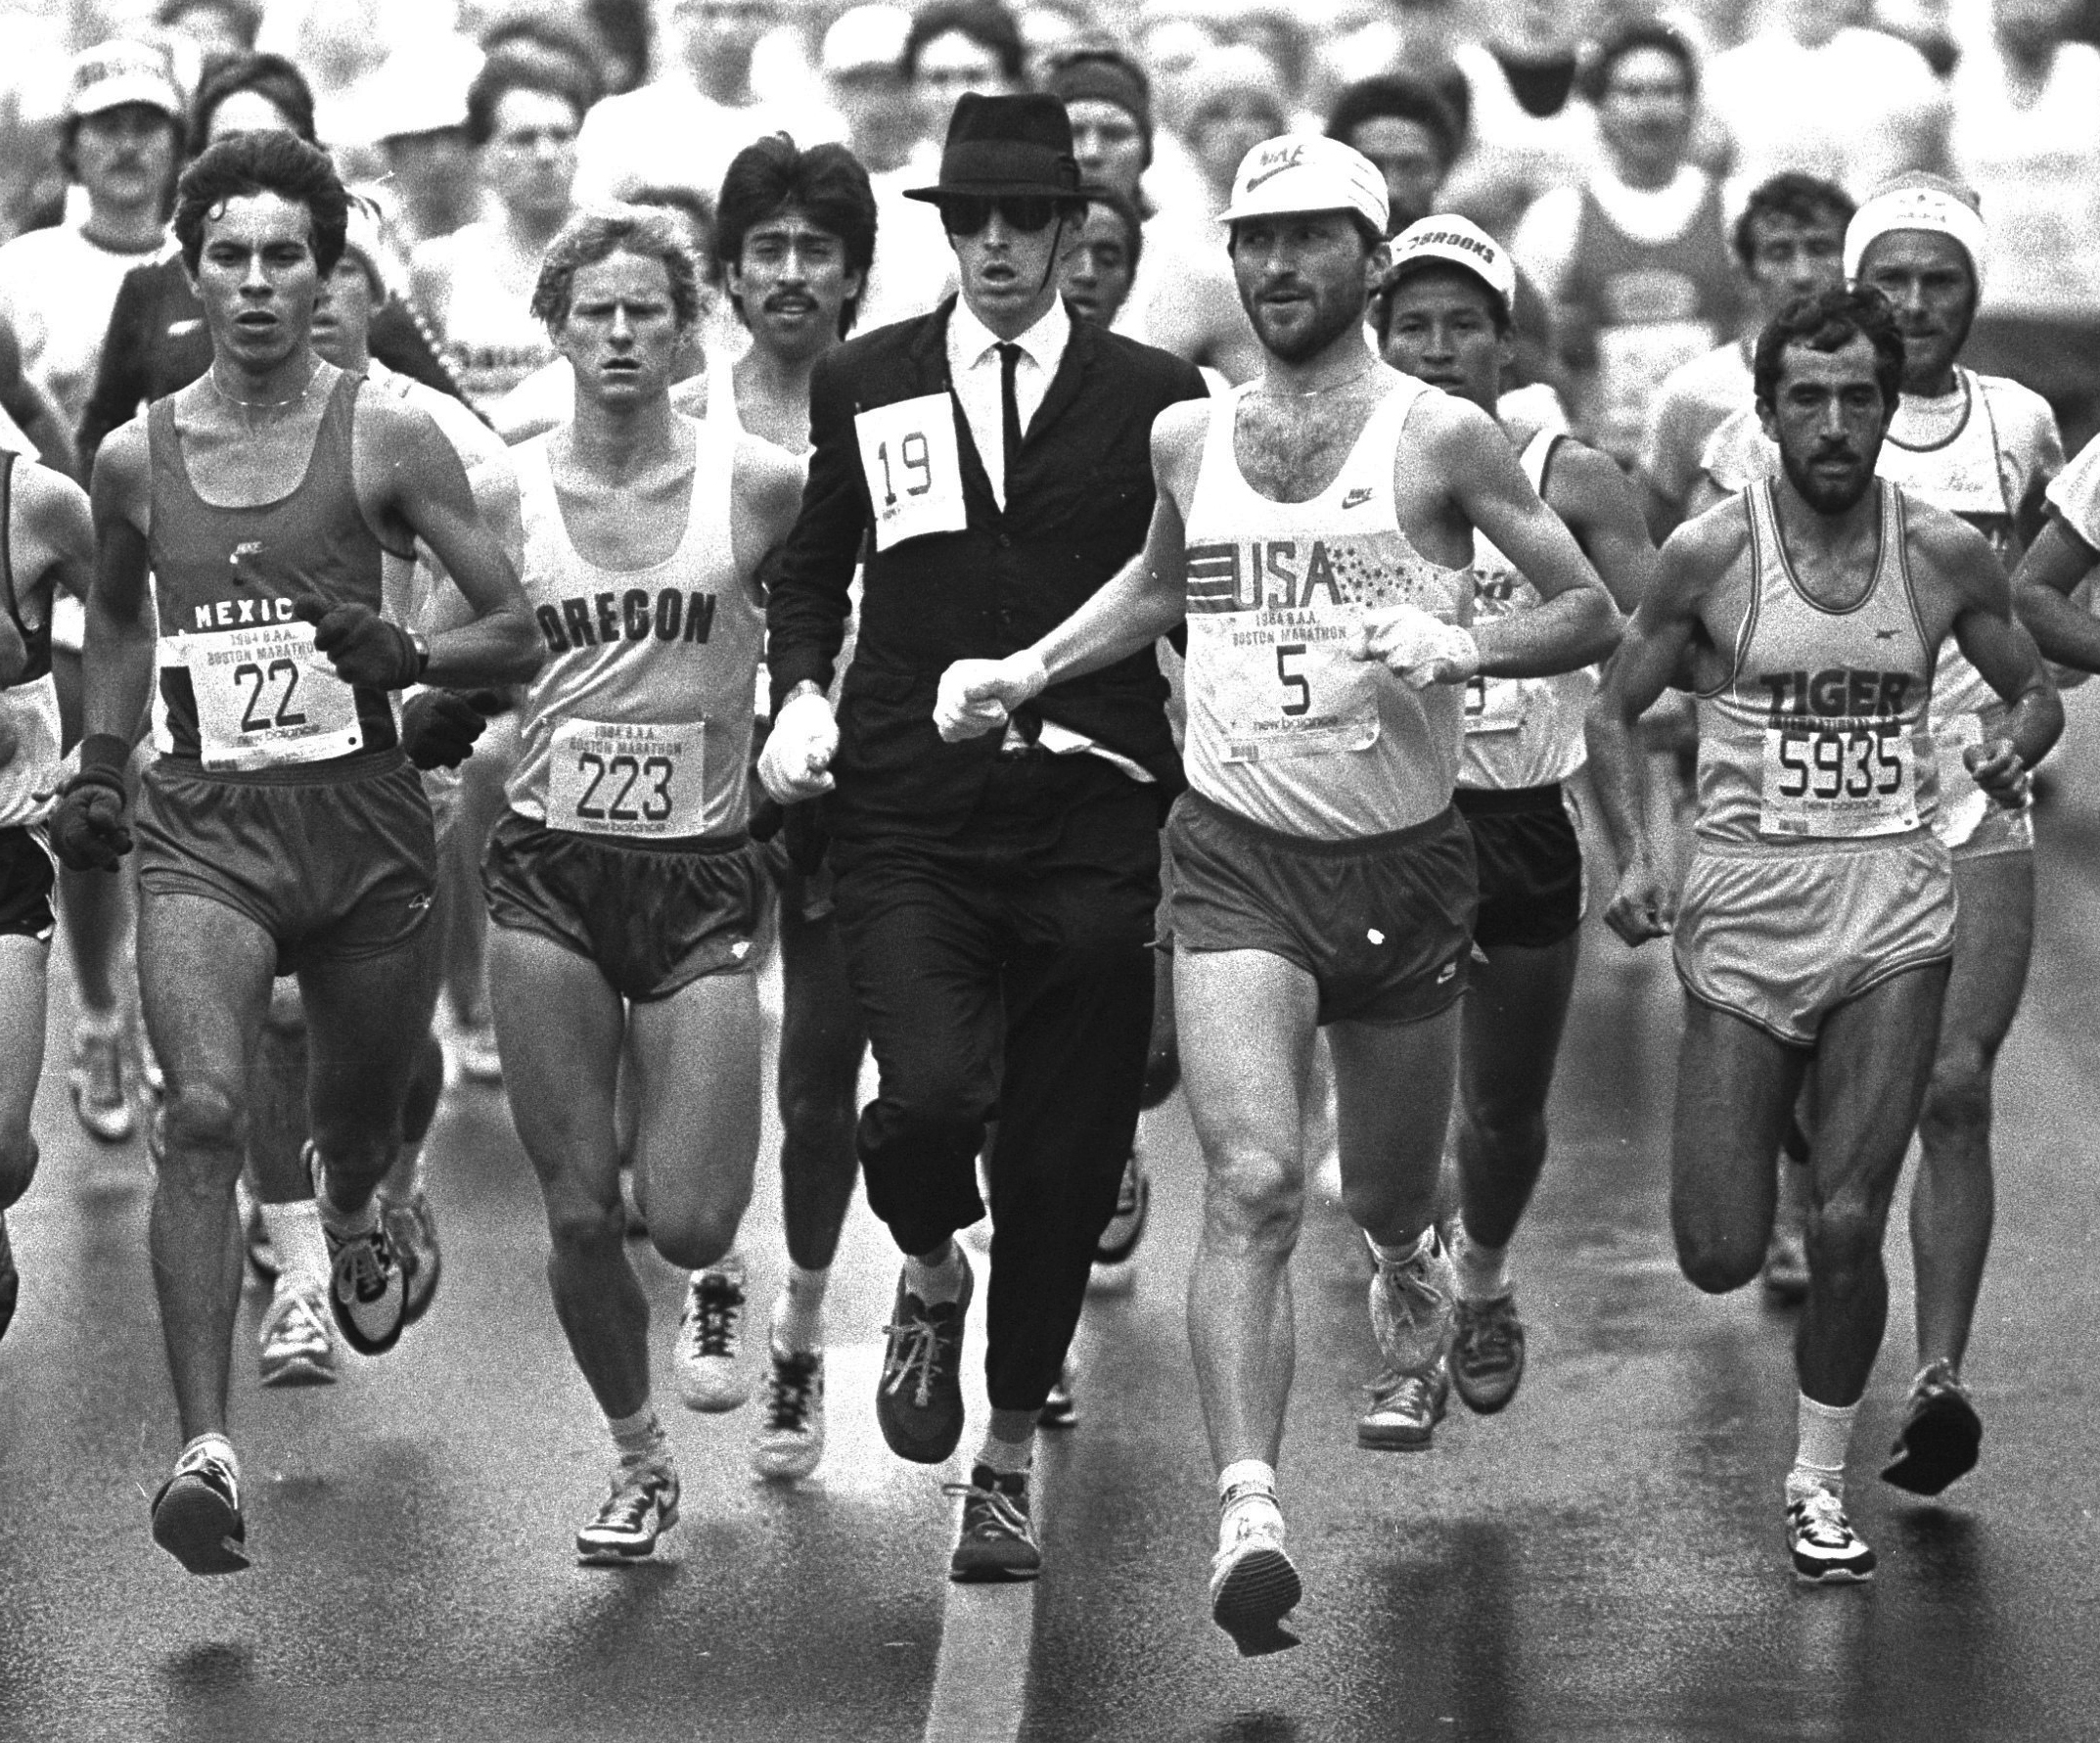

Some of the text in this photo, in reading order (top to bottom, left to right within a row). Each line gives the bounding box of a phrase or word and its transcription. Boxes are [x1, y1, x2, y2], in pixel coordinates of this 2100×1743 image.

[1419, 232, 1495, 264] BROOKS
[878, 432, 932, 506] 19
[1231, 541, 1343, 611] USA
[195, 598, 293, 628] MEXIC
[537, 588, 716, 653] OREGON
[1233, 625, 1347, 647] BOSTON MARATHON
[207, 640, 314, 665] BOSTON MARATHO
[1276, 644, 1310, 715] 5
[234, 658, 306, 732] 22
[1761, 669, 1909, 716] TIGER
[570, 736, 682, 756] BOSTON MARATHON
[1779, 731, 1901, 799] 5935
[576, 753, 673, 820] 223
